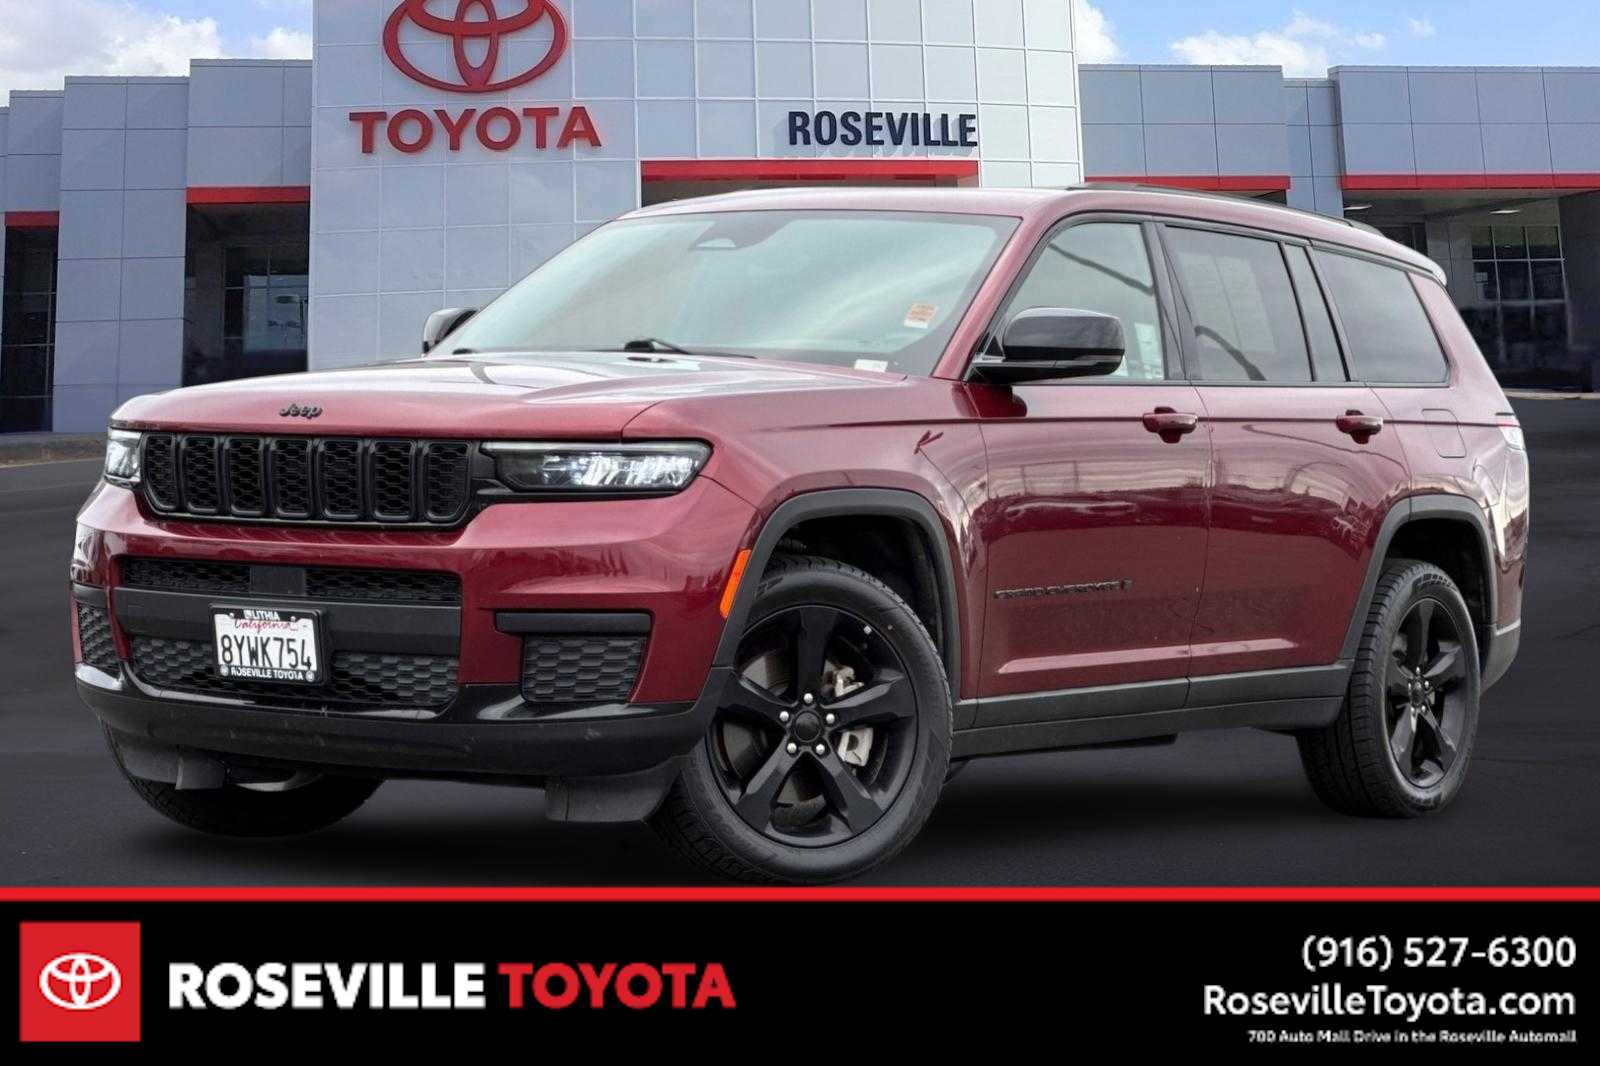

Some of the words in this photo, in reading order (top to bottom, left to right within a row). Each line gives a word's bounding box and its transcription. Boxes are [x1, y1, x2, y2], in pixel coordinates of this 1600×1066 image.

[349, 106, 603, 154] TOYOTA
[788, 110, 978, 148] ROSEVILLE
[279, 404, 323, 420] Jeep
[220, 634, 312, 670] 8YWK754
[230, 666, 272, 679] ROSEVILLE
[273, 669, 304, 681] TOYOTA
